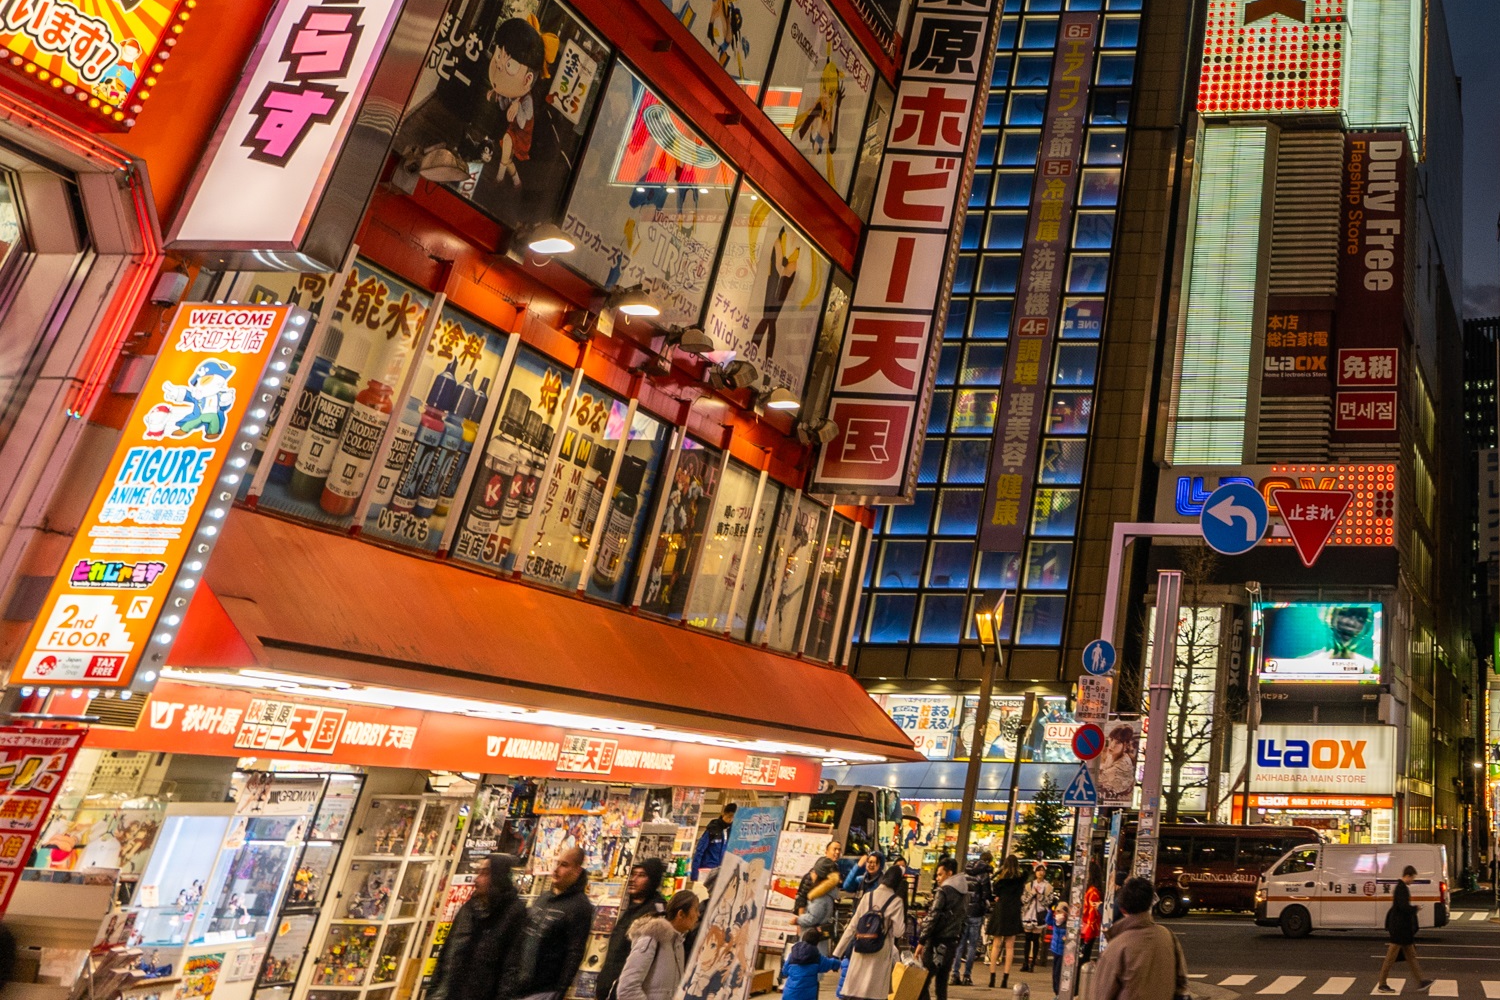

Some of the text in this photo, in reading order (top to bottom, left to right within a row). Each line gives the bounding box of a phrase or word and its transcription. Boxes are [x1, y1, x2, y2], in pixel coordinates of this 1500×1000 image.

[1067, 24, 1091, 39] 6F
[1047, 161, 1072, 176] 5F
[1346, 140, 1367, 256] Flagship Store
[1364, 140, 1402, 292] Duty Free
[190, 311, 274, 327] WELCOME
[1021, 320, 1046, 336] 4F
[1267, 314, 1300, 331] 本店
[178, 330, 266, 350] 欢迎光临
[1266, 331, 1329, 349] 総合家電
[1342, 354, 1394, 380] 免税
[1338, 400, 1394, 423] 면세점
[119, 449, 214, 484] FIGURE
[108, 487, 197, 506] ANIME GOODS
[1288, 503, 1336, 522] 止まれ
[70, 560, 168, 583] とれじゃらす
[56, 604, 97, 631] 2nd
[47, 631, 110, 648] FLOOR
[95, 656, 118, 668] TAX
[91, 666, 115, 678] FREE
[341, 726, 388, 747] HOBBY
[386, 726, 418, 750] 天国
[502, 737, 560, 762] AKIHABARA
[1255, 773, 1367, 784] AKIHABARA MAIN STORE
[1344, 798, 1367, 807] STORE
